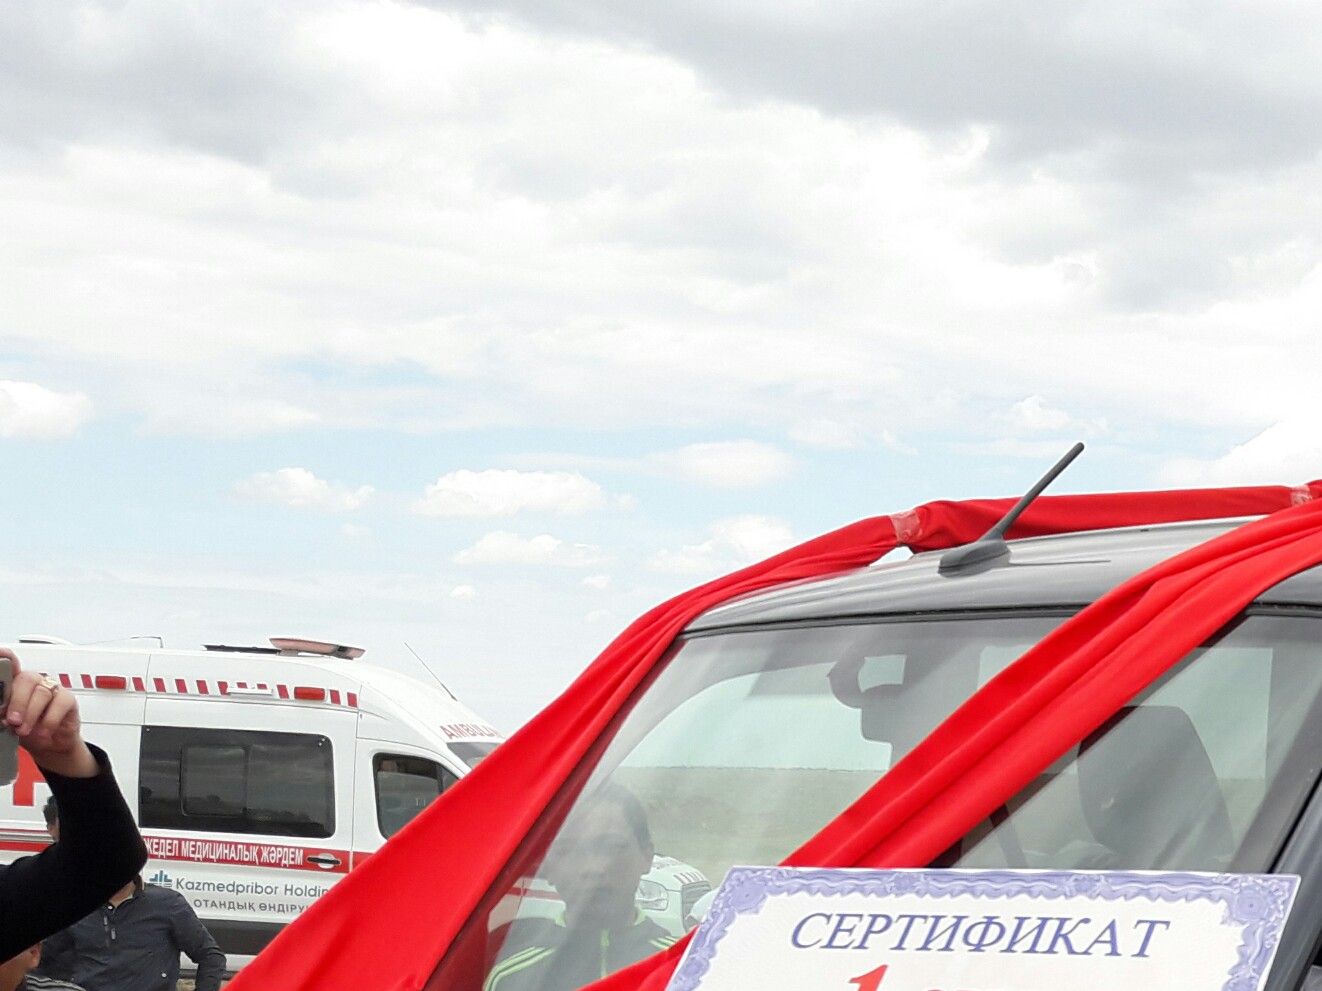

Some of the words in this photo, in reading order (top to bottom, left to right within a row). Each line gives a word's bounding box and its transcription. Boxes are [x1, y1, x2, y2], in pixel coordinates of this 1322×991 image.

[143, 837, 180, 859] ЖЕДЕЛ
[181, 840, 259, 866] МЕДИЦИНАЛЫҚ
[260, 846, 303, 867] ЖӘРДЕМ
[176, 877, 279, 898] Kazmedpribor
[193, 898, 256, 911] ОТАНДЫҚ
[790, 911, 1170, 960] СЕРТИФИКАТ
